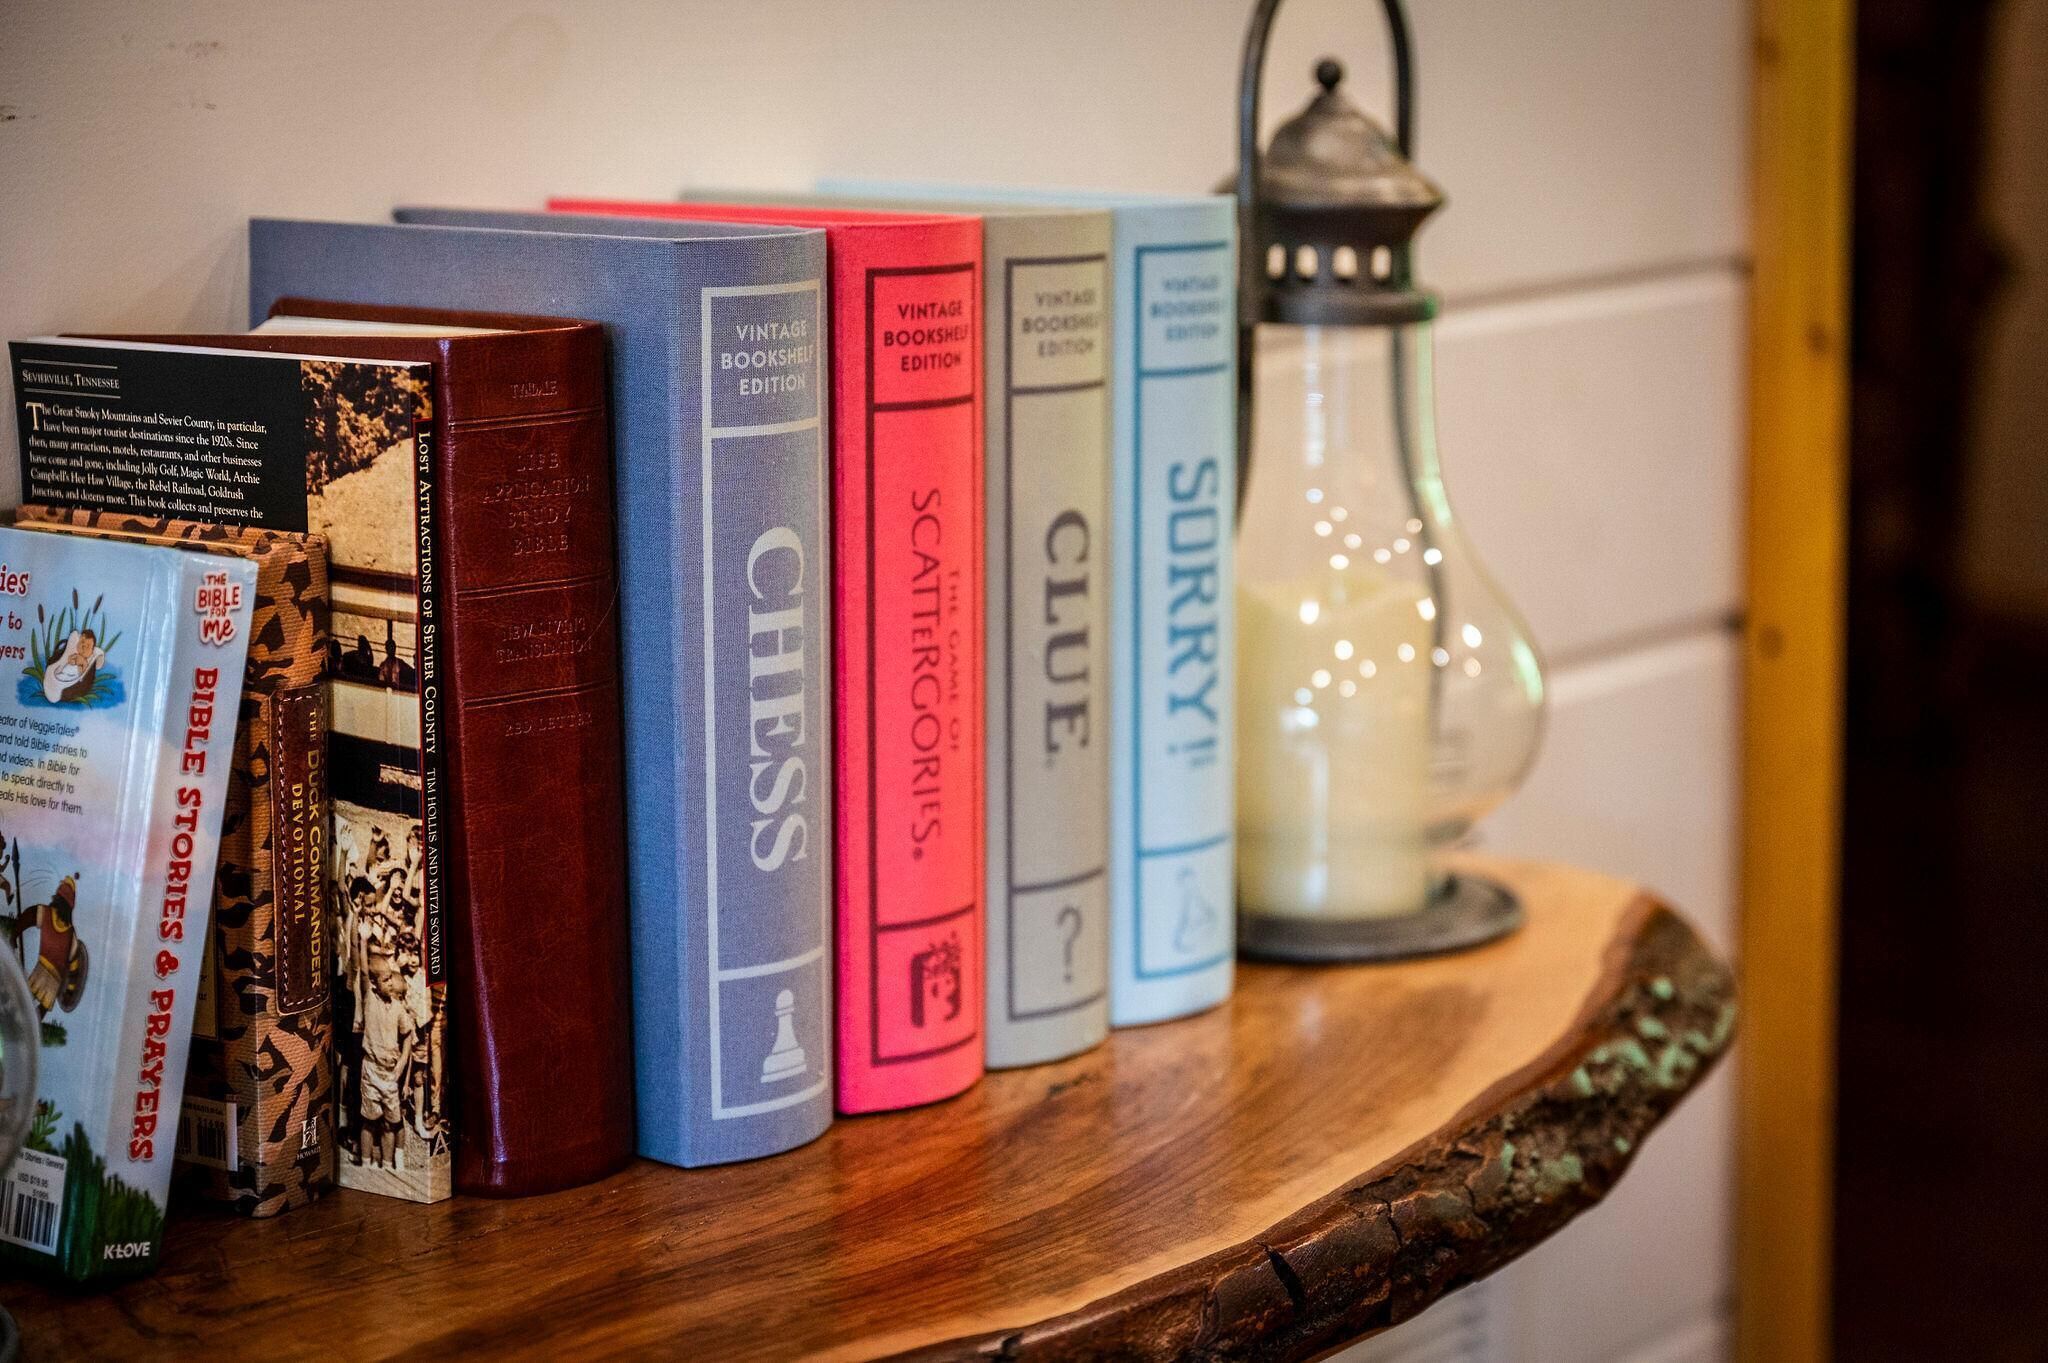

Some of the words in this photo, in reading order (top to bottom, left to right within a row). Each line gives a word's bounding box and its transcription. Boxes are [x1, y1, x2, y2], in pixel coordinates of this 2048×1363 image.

[898, 300, 963, 320] VINTAGE
[736, 319, 807, 341] VINTAGE
[883, 324, 968, 347] BOOKSHELF
[720, 344, 814, 370] BOOKSHELF
[901, 352, 961, 372] EDITION
[739, 374, 806, 396] EDITION
[26, 401, 51, 431] The
[52, 403, 73, 418] Great
[75, 406, 99, 421] Smoky
[101, 408, 142, 423] Mountains
[143, 412, 157, 424] and
[159, 413, 182, 426] Sevier
[184, 415, 216, 431] County,
[217, 419, 226, 430] in
[227, 421, 267, 434] particular,
[43, 419, 60, 433] have
[62, 421, 80, 435] been
[81, 425, 102, 439] major
[104, 425, 127, 438] tourist
[128, 427, 174, 441] destinations
[175, 432, 194, 444] since
[196, 433, 209, 446] the
[211, 435, 234, 448] 1920s.
[236, 436, 259, 450] Since
[49, 440, 69, 452] many
[70, 441, 111, 454] attractions,
[112, 443, 139, 457] motels,
[140, 447, 183, 461] restaurants,
[184, 450, 199, 461] and
[200, 451, 221, 464] other
[222, 452, 263, 467] businesses
[417, 431, 431, 473] LOST
[29, 451, 47, 464] have
[48, 456, 68, 467] come
[69, 456, 83, 468] and
[84, 460, 104, 470] gone,
[106, 459, 140, 475] including
[141, 462, 158, 476] Jolly
[159, 463, 179, 478] Golf,
[180, 466, 204, 480] Magic
[205, 468, 232, 483] World,
[233, 471, 260, 485] Archie
[30, 467, 70, 484] Campbell's
[87, 473, 105, 486] Haw
[106, 474, 134, 490] Village,
[135, 478, 148, 490] the
[149, 479, 171, 493] Rebel
[172, 481, 207, 498] Railroad,
[208, 485, 244, 500] Goldrush
[31, 483, 64, 499] Junction,
[65, 487, 79, 499] and
[80, 490, 105, 503] dozens
[106, 495, 127, 505] more.
[128, 494, 146, 507] This
[147, 496, 166, 509] book
[167, 499, 196, 512] collects
[198, 502, 212, 514] and
[213, 506, 249, 517] preserves
[250, 507, 264, 518] the
[419, 479, 433, 594] ATTRACTIONS
[206, 573, 227, 585] THE
[198, 586, 240, 608] BIBLE
[210, 607, 227, 618] FOR
[422, 599, 433, 618] OF
[8, 610, 22, 630] to
[203, 619, 234, 641] me
[1043, 507, 1091, 755] CLUE
[423, 624, 436, 681] SEVIER
[747, 526, 808, 872] CHESS
[20, 717, 28, 729] of
[182, 667, 218, 774] BIBLE
[308, 708, 318, 742] THE
[424, 685, 437, 754] COUNTY
[14, 736, 29, 748] told
[30, 737, 50, 752] Bible
[51, 744, 77, 757] stories
[79, 747, 88, 759] to
[1, 771, 9, 782] to
[11, 773, 34, 786] speak
[36, 777, 65, 794] directly
[66, 783, 74, 794] to
[37, 758, 45, 769] In
[47, 760, 67, 774] Bible
[69, 762, 80, 776] for
[426, 767, 436, 794] TIM
[16, 791, 29, 804] His
[30, 794, 47, 808] love
[48, 797, 60, 810] for
[307, 750, 320, 821] DUCK
[427, 796, 438, 843] HOLLIS
[159, 786, 202, 942] STORIES
[291, 783, 305, 925] DEVOTIONAL
[428, 844, 438, 876] AND
[308, 826, 321, 988] COMMANDER
[429, 878, 439, 915] MITZI
[430, 917, 441, 975] SOWARD
[154, 949, 179, 978] &
[128, 988, 175, 1162] PRAYERS
